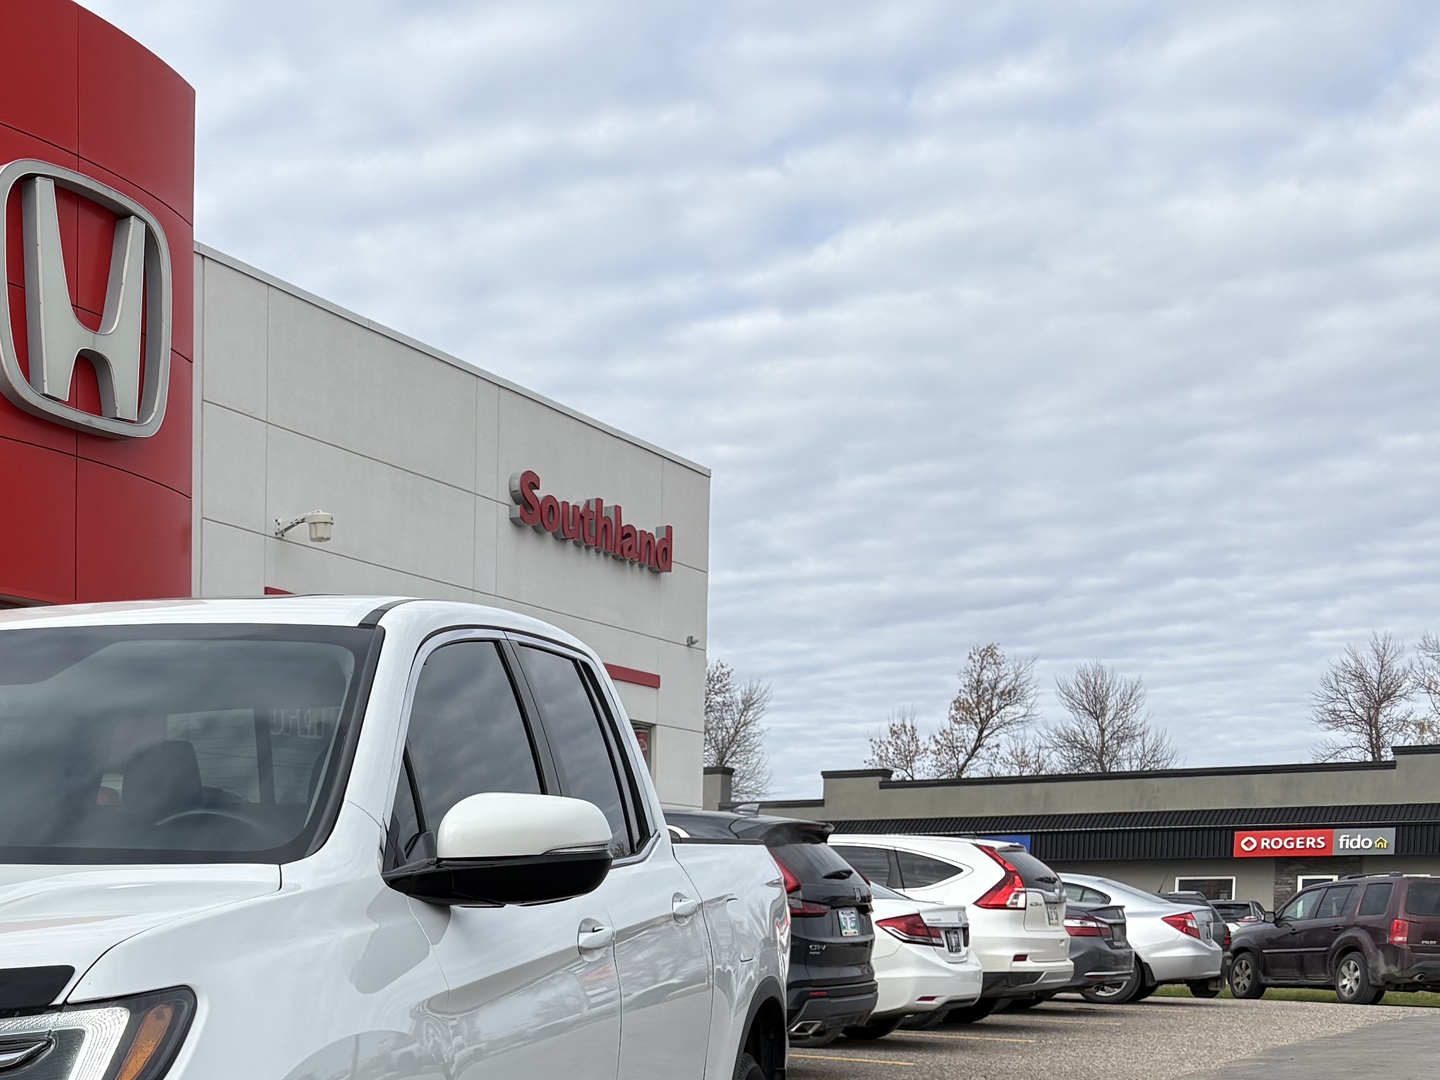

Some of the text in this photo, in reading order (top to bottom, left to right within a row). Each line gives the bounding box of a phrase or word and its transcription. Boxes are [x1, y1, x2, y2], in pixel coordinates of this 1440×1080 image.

[509, 470, 673, 573] Southland
[1260, 834, 1373, 850] ROGERS fido
